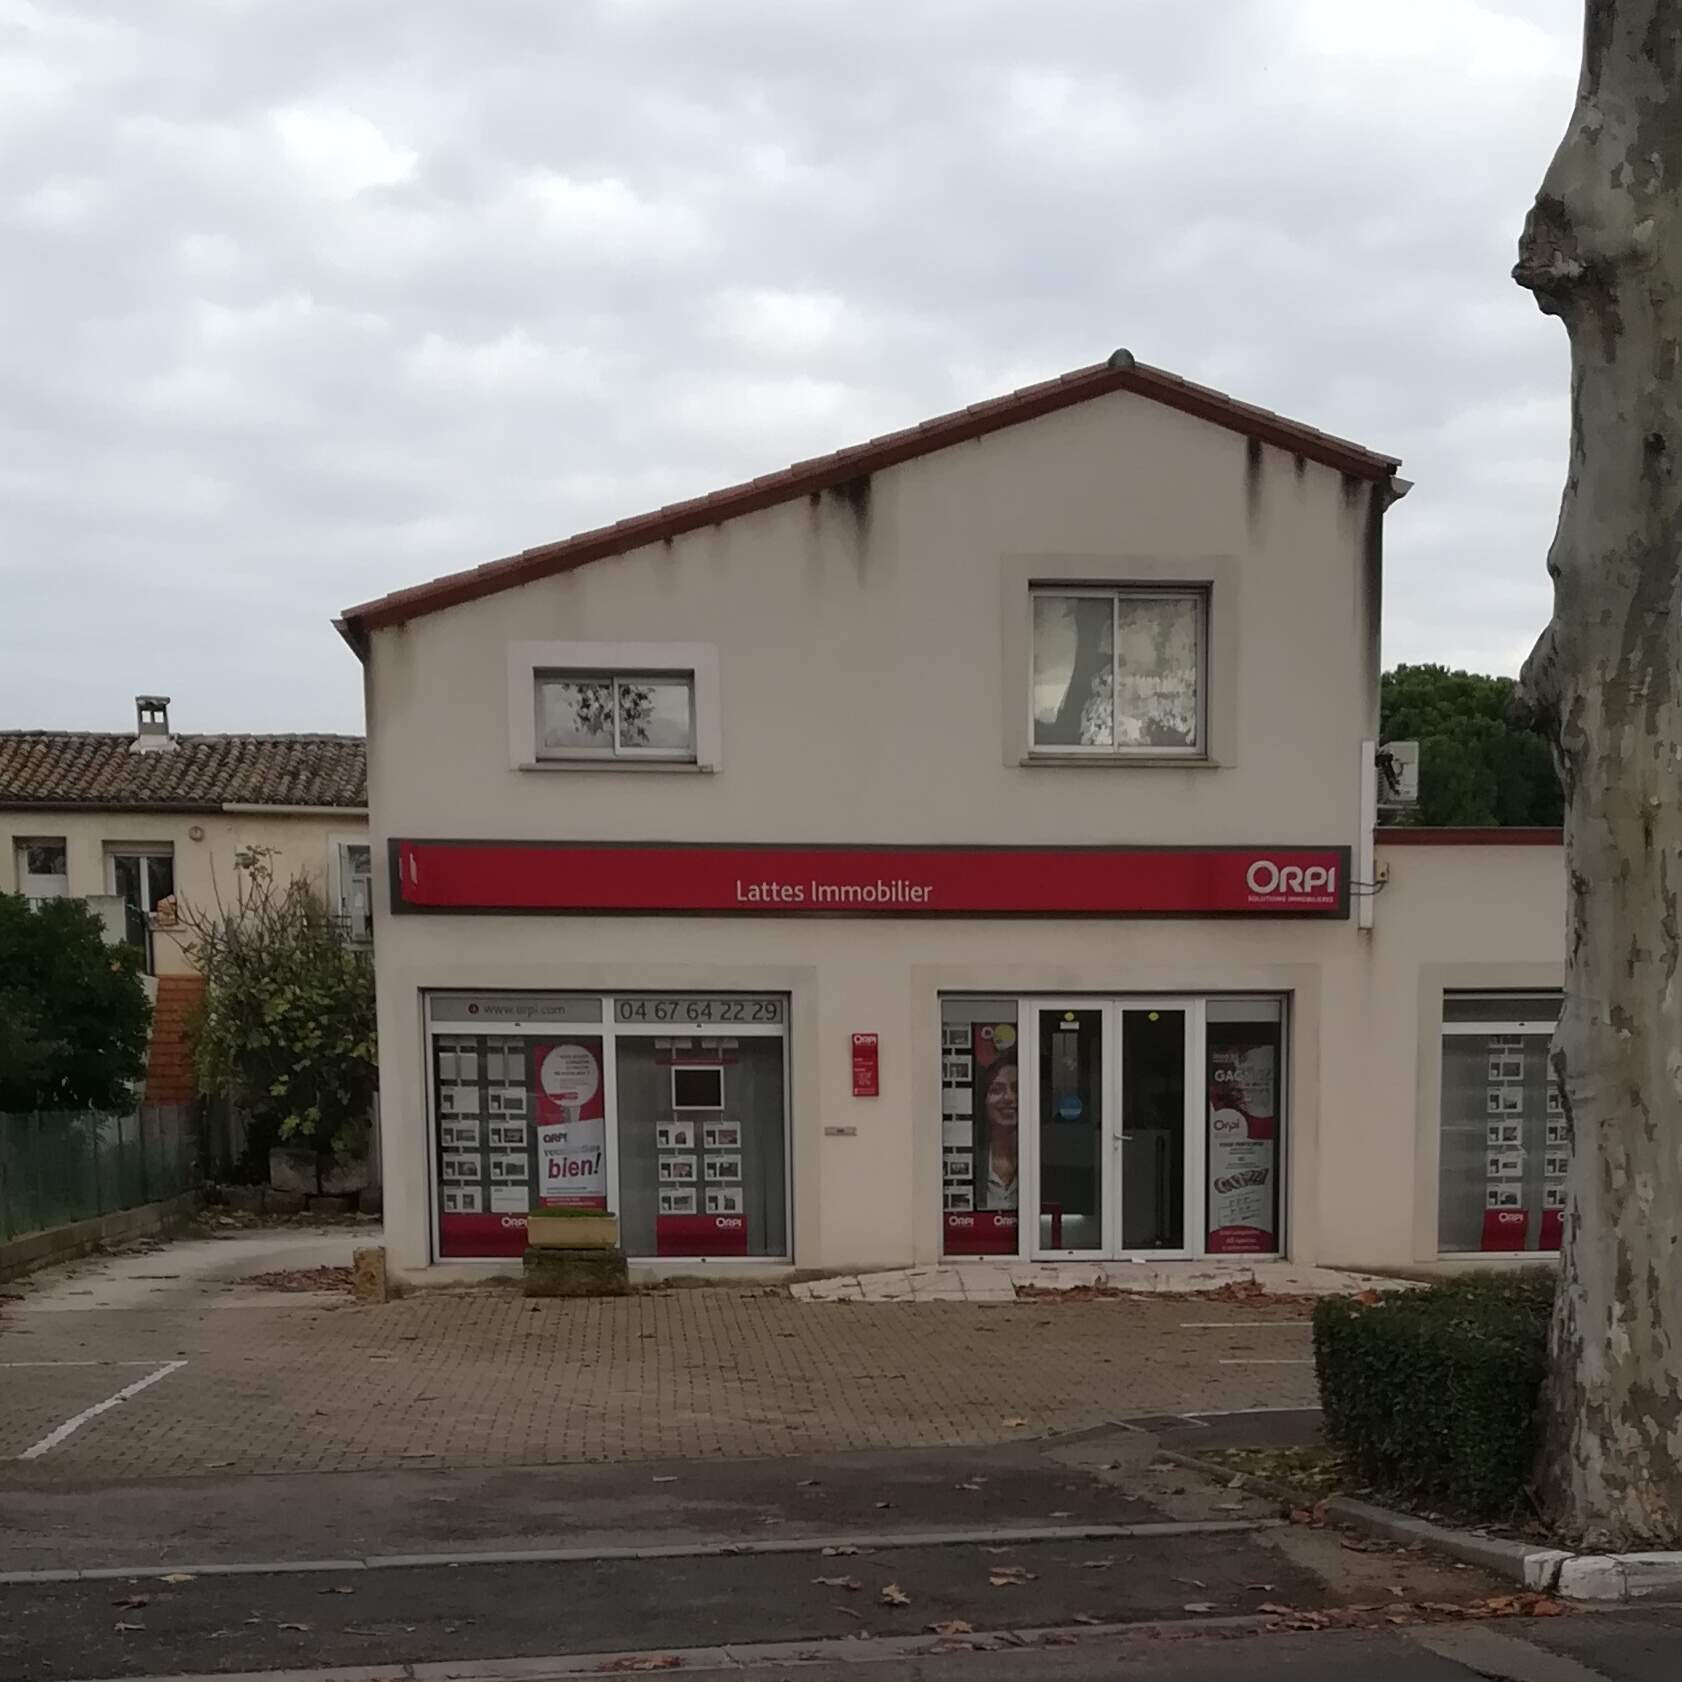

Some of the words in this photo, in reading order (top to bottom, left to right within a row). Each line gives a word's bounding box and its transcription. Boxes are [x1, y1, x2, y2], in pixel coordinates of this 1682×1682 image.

[736, 880, 804, 901] Lattes
[811, 880, 933, 902] Immobilier
[483, 1004, 566, 1017] www.orpi.com
[620, 1002, 647, 1020] 04
[654, 1002, 680, 1020] 67
[686, 1002, 712, 1020] 64
[719, 1002, 745, 1020] 22
[751, 1002, 778, 1020] 29
[548, 1152, 602, 1179] bien!
